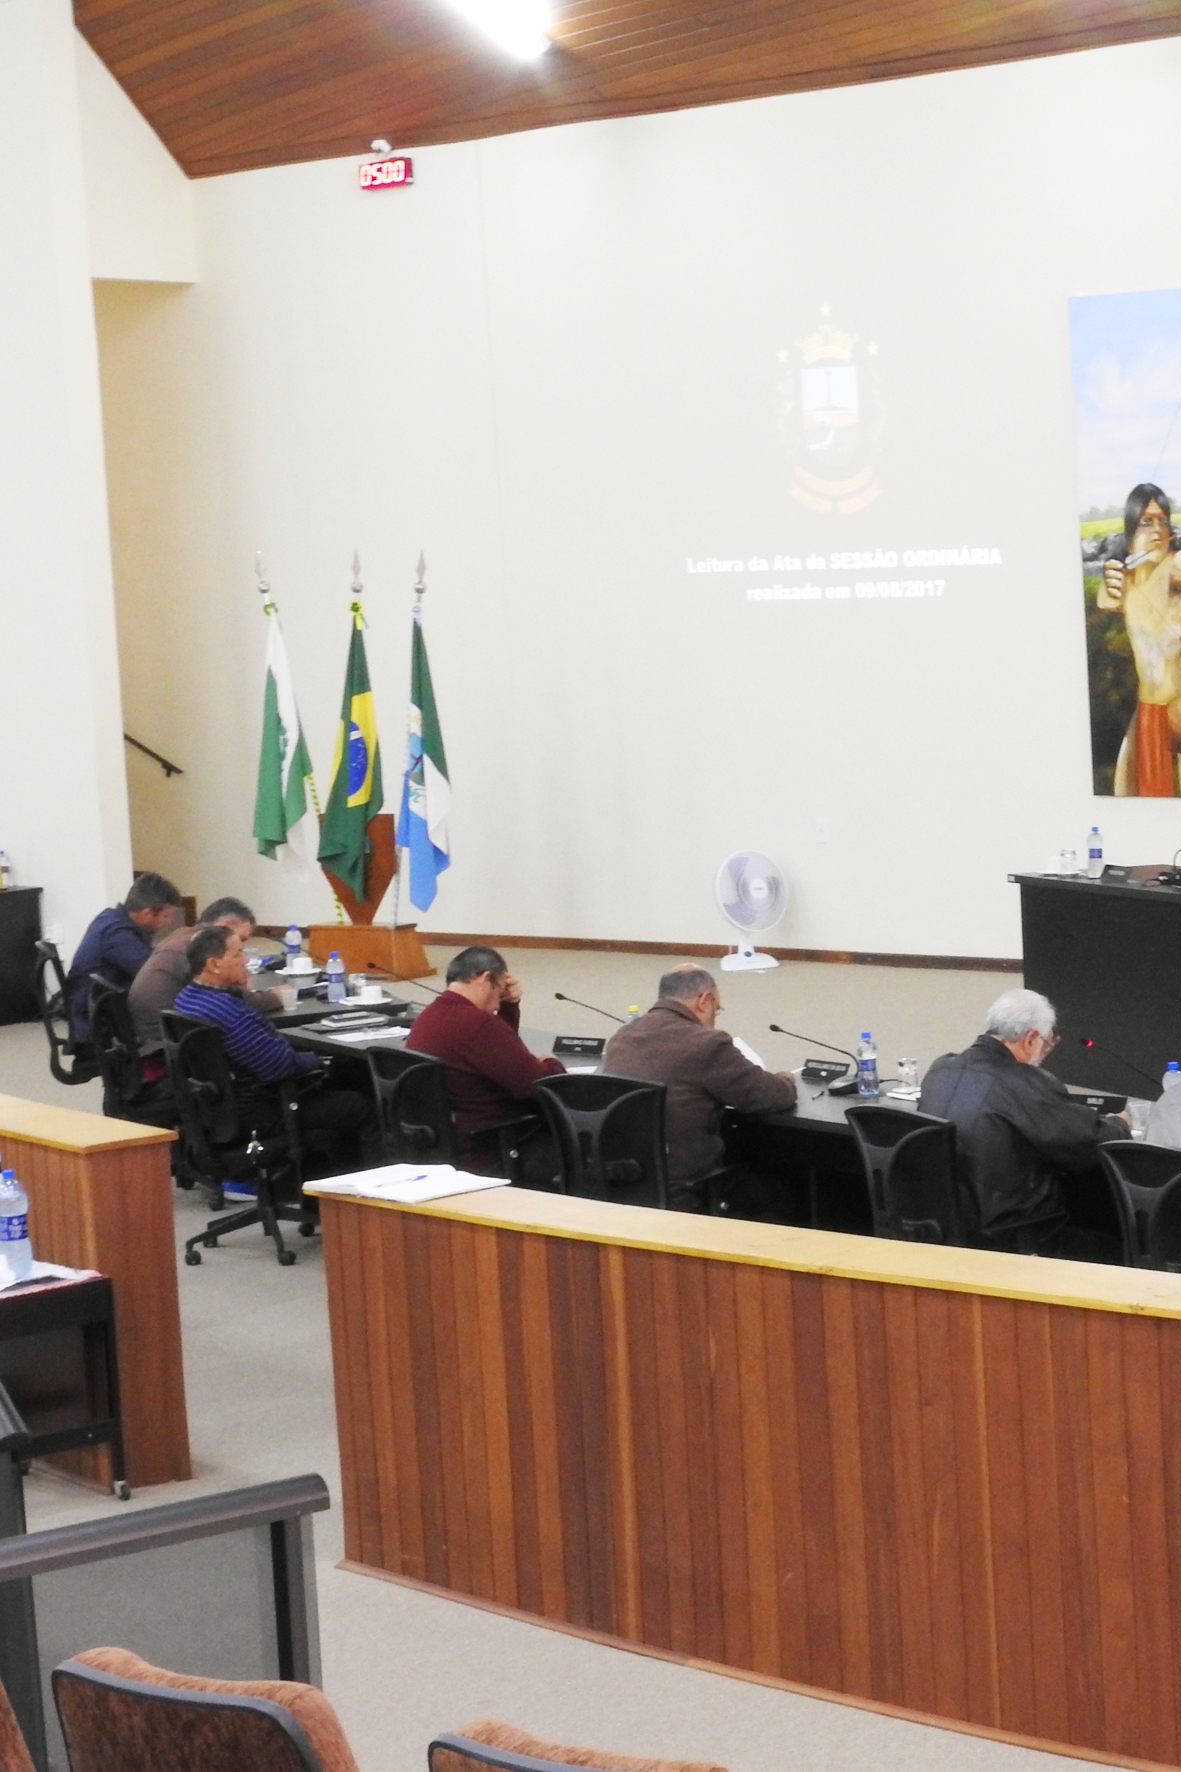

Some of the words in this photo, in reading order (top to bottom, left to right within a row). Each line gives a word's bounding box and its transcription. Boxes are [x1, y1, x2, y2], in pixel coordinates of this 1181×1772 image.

[686, 556, 745, 574] Leitura
[748, 556, 769, 572] da
[772, 554, 802, 571] Ata
[805, 553, 827, 570] da
[829, 548, 899, 569] SESSÃO
[902, 546, 1003, 568] ORDINÁRIA
[746, 583, 822, 601] realizada
[824, 586, 852, 600] em
[854, 580, 946, 599] 09/08/2017
